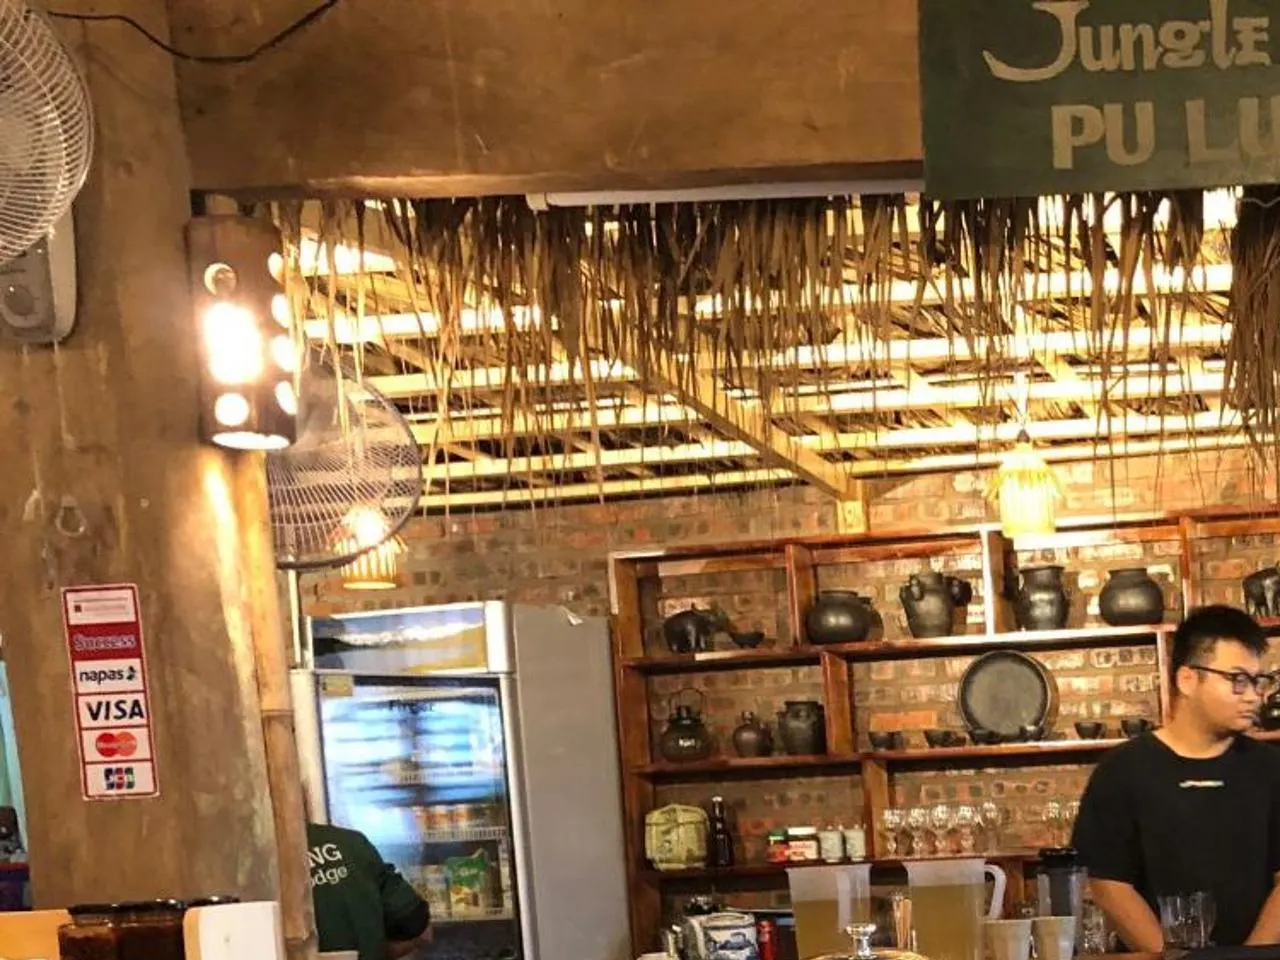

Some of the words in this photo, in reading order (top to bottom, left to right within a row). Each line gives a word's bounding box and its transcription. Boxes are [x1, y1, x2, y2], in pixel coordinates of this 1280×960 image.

[1051, 100, 1156, 170] PU
[79, 669, 124, 685] napas
[85, 699, 145, 720] VISA
